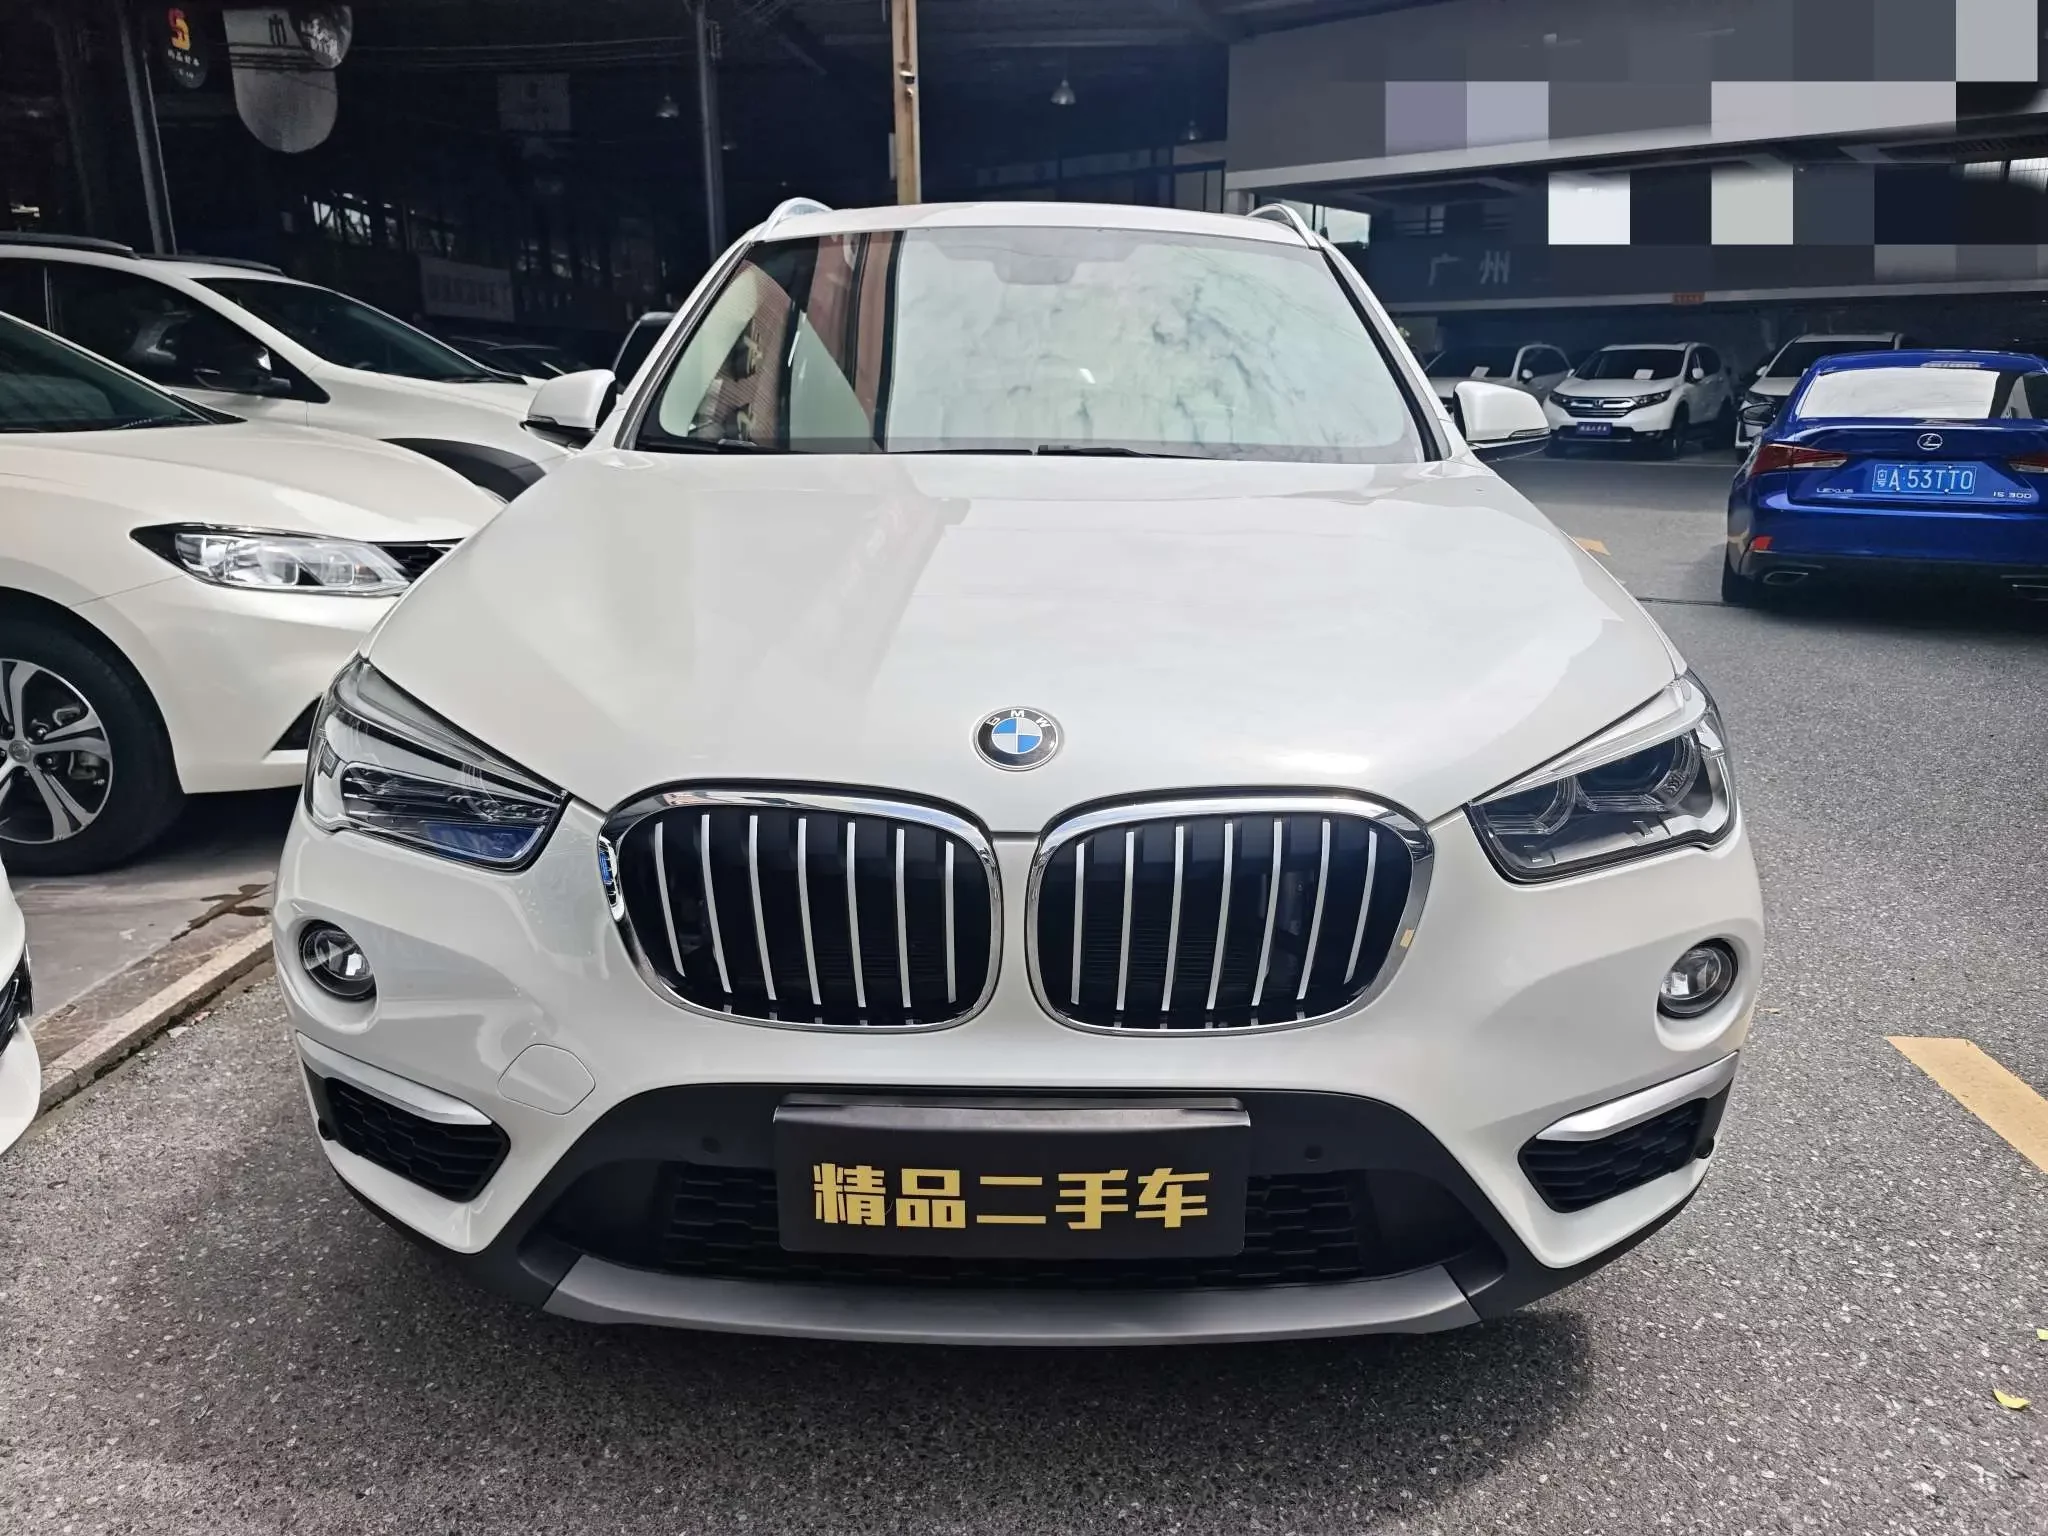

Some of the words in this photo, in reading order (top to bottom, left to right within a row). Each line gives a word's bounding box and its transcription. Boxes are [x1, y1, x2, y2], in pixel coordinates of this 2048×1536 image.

[1427, 250, 1511, 287] 广州
[813, 1163, 1210, 1229] 精品二手车
